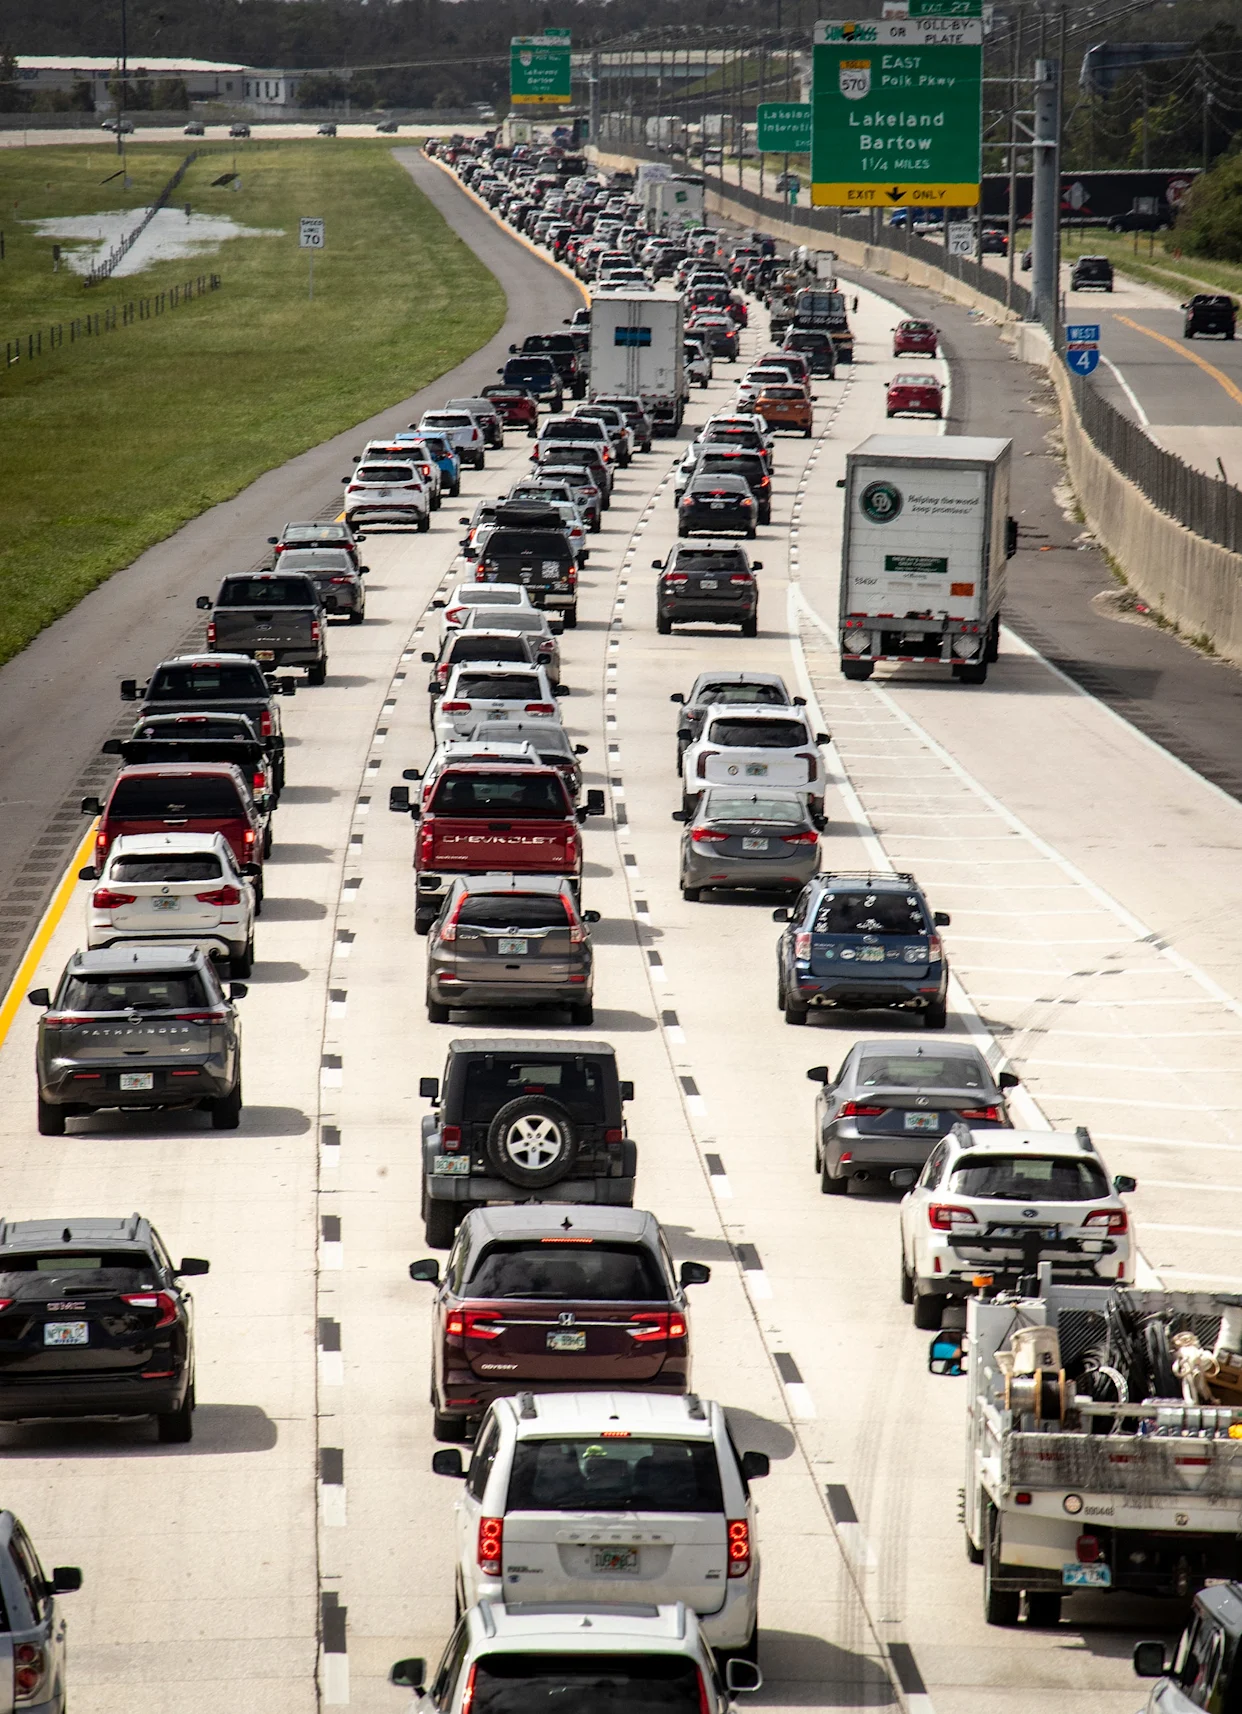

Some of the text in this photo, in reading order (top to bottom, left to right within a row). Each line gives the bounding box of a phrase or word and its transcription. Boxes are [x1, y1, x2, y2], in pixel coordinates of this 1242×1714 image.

[951, 1, 970, 13] 27
[889, 26, 907, 38] OR
[924, 34, 964, 44] PLATE
[881, 54, 921, 69] EAST
[841, 78, 866, 91] 570
[881, 75, 956, 88] Polk Pkwy
[848, 111, 945, 127] Lakeland
[859, 134, 932, 150] Bartow
[894, 159, 931, 169] MILES
[847, 190, 947, 200] EXIT ONLY
[303, 234, 321, 245] 70
[951, 240, 970, 252] 70
[1070, 327, 1097, 340] WEST
[1075, 350, 1091, 370] 4
[442, 835, 557, 844] CHEVROLET
[81, 1027, 190, 1036] PATHFINDER
[46, 1301, 87, 1312] GMC
